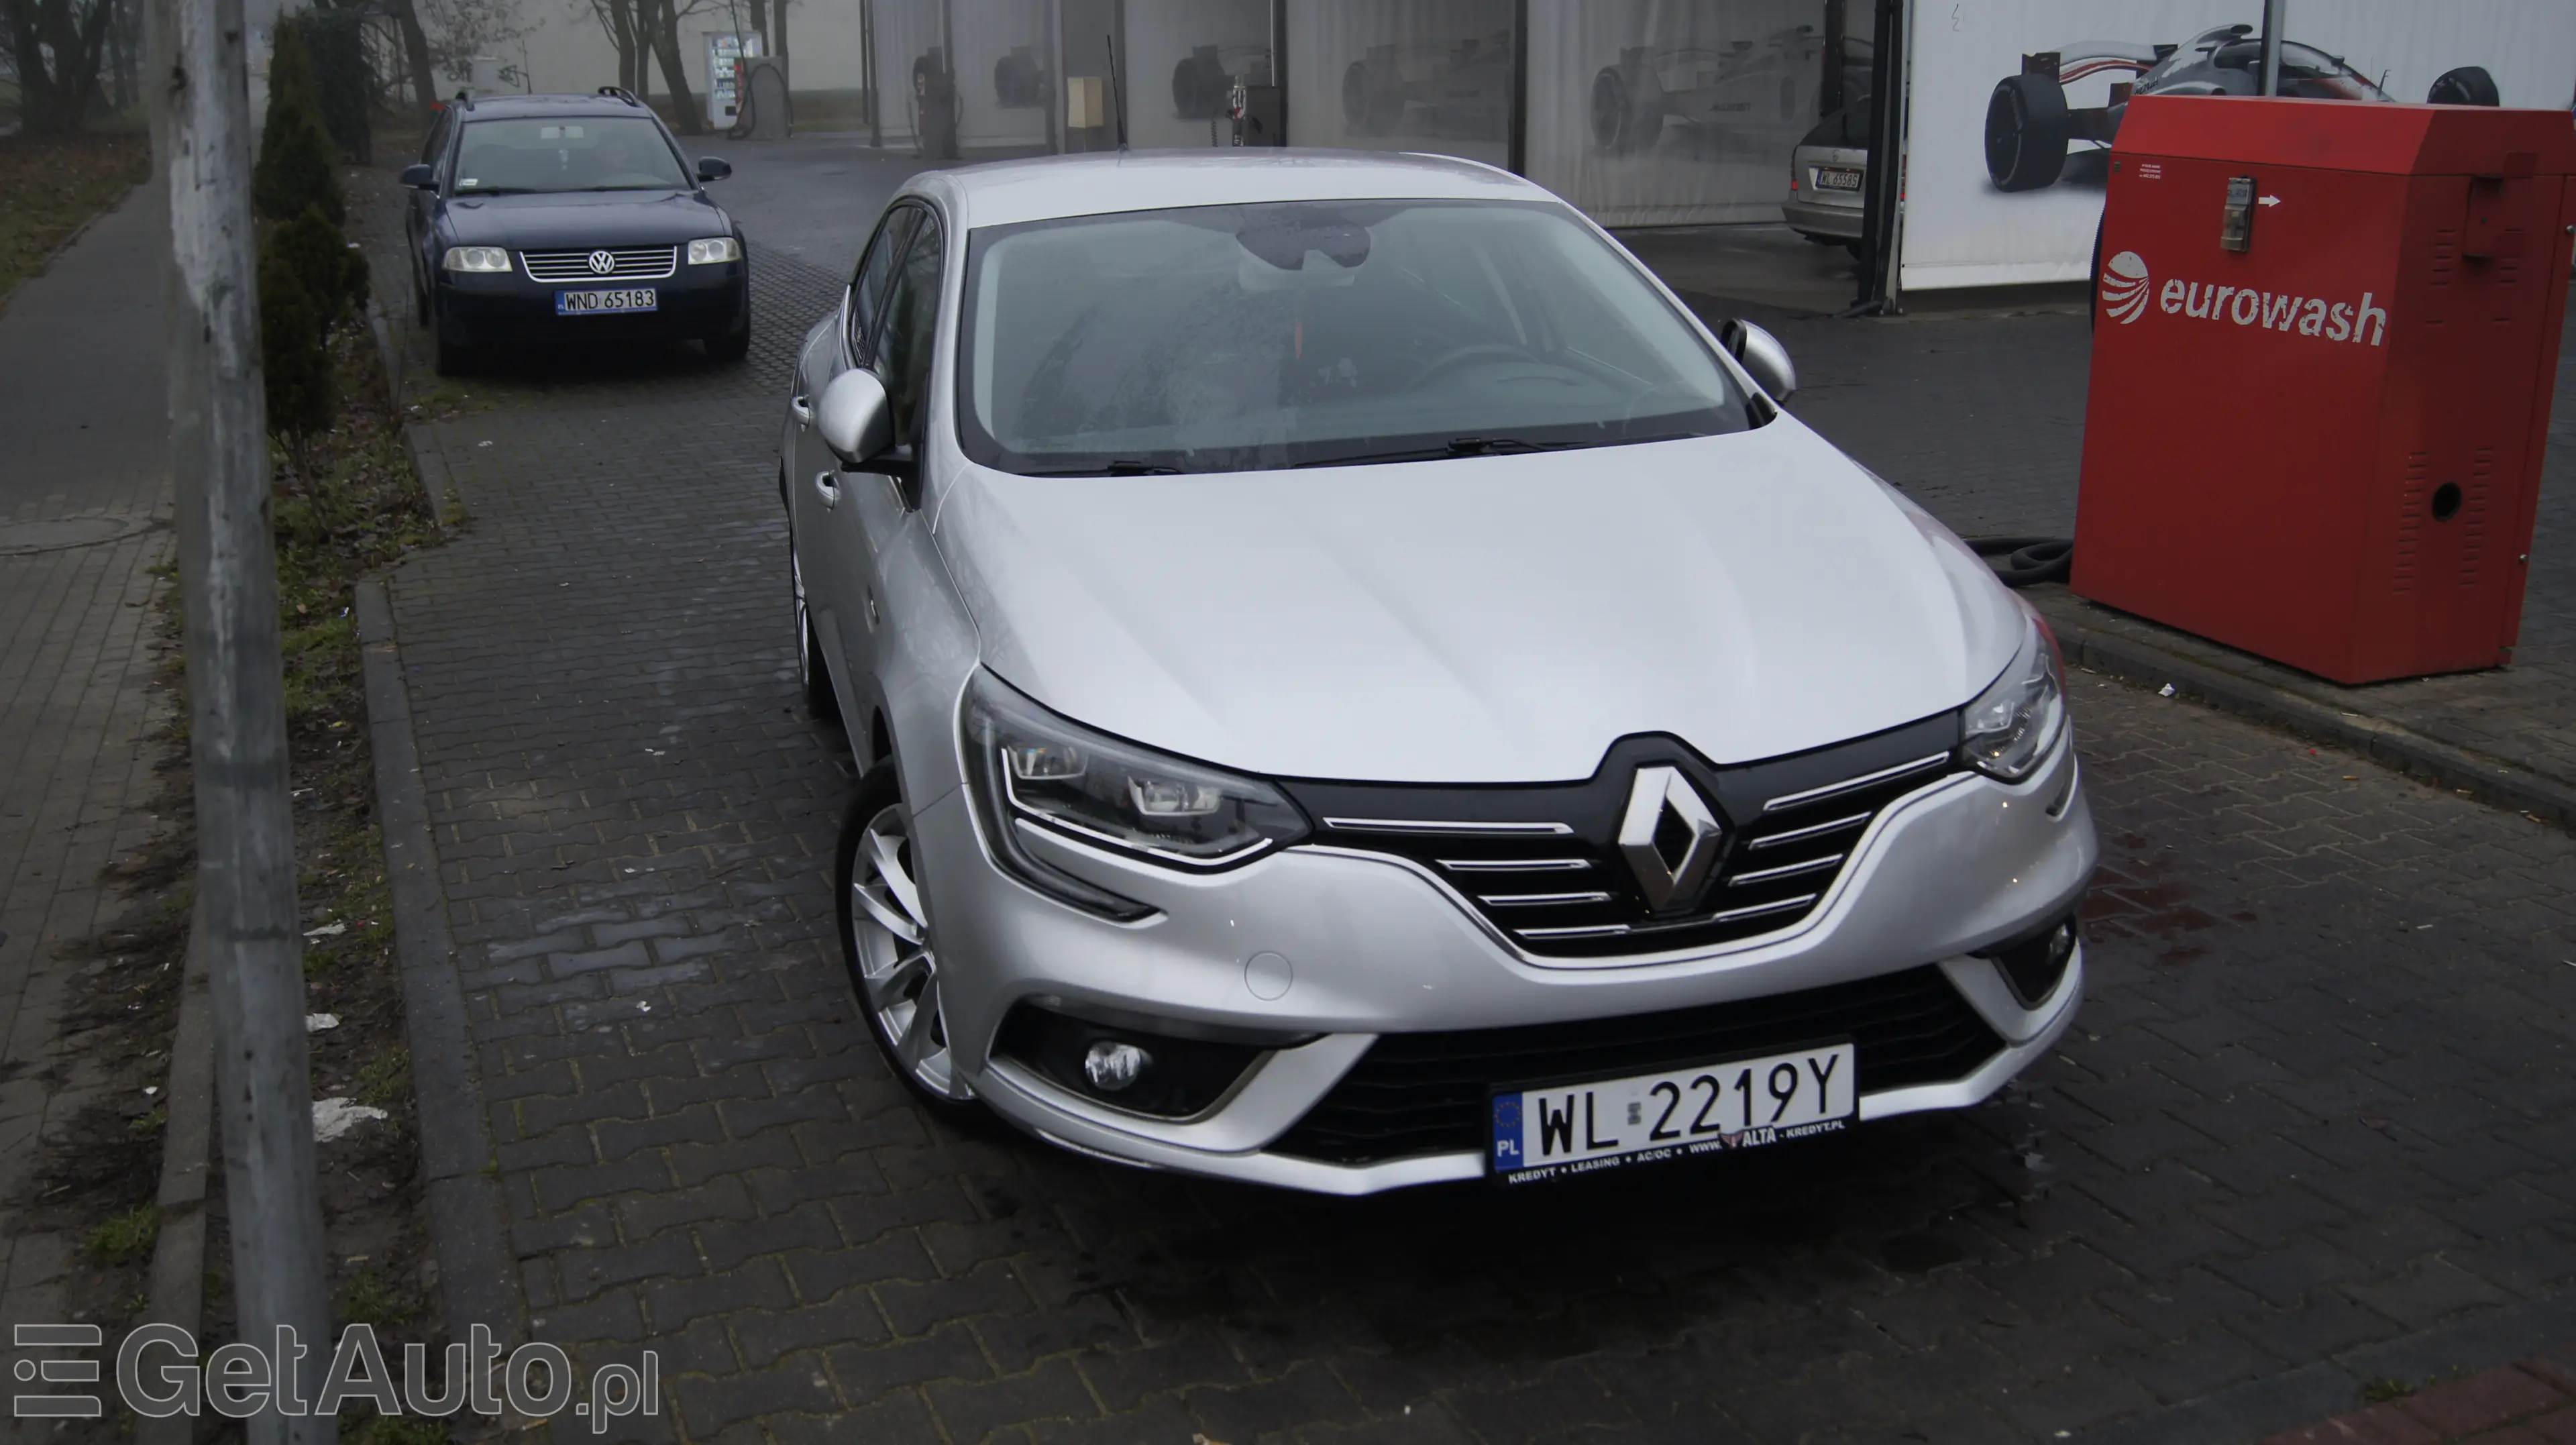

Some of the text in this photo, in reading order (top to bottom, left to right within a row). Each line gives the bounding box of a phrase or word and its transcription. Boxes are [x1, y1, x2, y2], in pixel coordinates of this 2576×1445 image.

[566, 290, 655, 311] WND 65183
[2160, 278, 2387, 346] eurowash
[1538, 1054, 1839, 1156] WL 2219Y
[1497, 1140, 1519, 1158] PL
[1508, 1167, 1556, 1184] KREDYT
[1570, 1156, 1621, 1173] LEASING
[1636, 1148, 1672, 1163] AC/OC
[1742, 1127, 1777, 1147] ALTA
